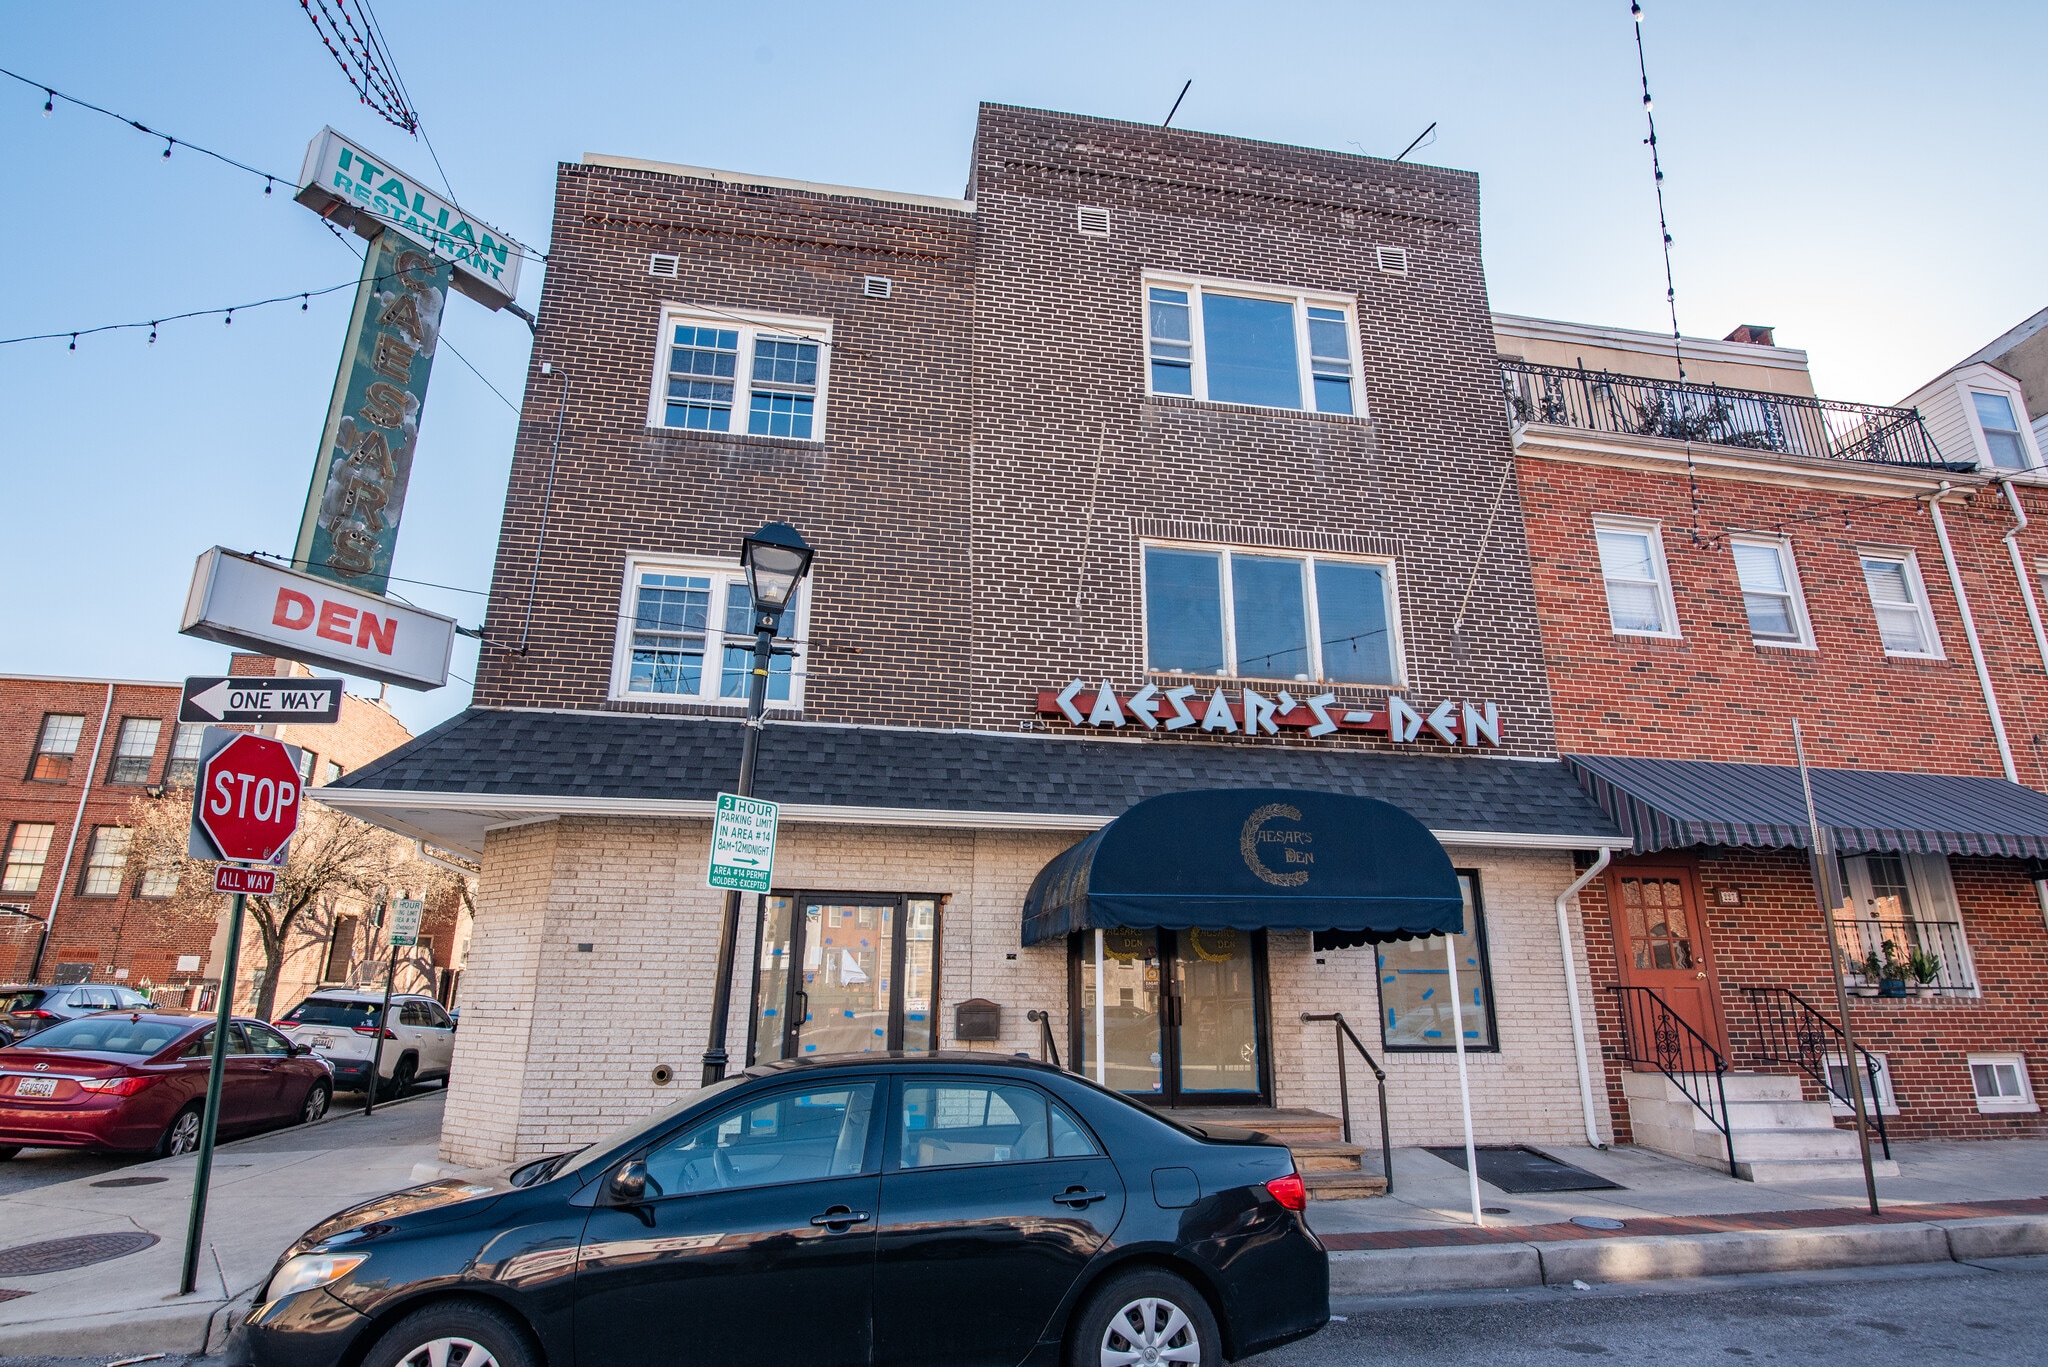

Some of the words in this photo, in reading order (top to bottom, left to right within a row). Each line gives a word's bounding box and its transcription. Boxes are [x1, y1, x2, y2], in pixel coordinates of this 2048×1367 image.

[338, 147, 509, 265] ITALIAN
[333, 170, 504, 281] RESTAURANT
[272, 587, 398, 656] DEN
[230, 692, 273, 709] ONE
[281, 692, 325, 709] WAY
[210, 770, 295, 823] STOP
[723, 797, 732, 809] 3
[738, 801, 773, 817] HOUR
[720, 812, 752, 826] PARKING
[755, 818, 773, 829] LIMIT
[719, 825, 729, 837] IN
[731, 827, 753, 840] AREA
[1285, 847, 1315, 864] DEN
[220, 872, 240, 888] ALL
[247, 874, 271, 890] WAY
[713, 865, 731, 876] AREA
[746, 870, 768, 881] PERMIT
[712, 876, 738, 886] HOLDERS
[739, 879, 767, 890] EXCEPTED
[399, 901, 420, 909] HOUR
